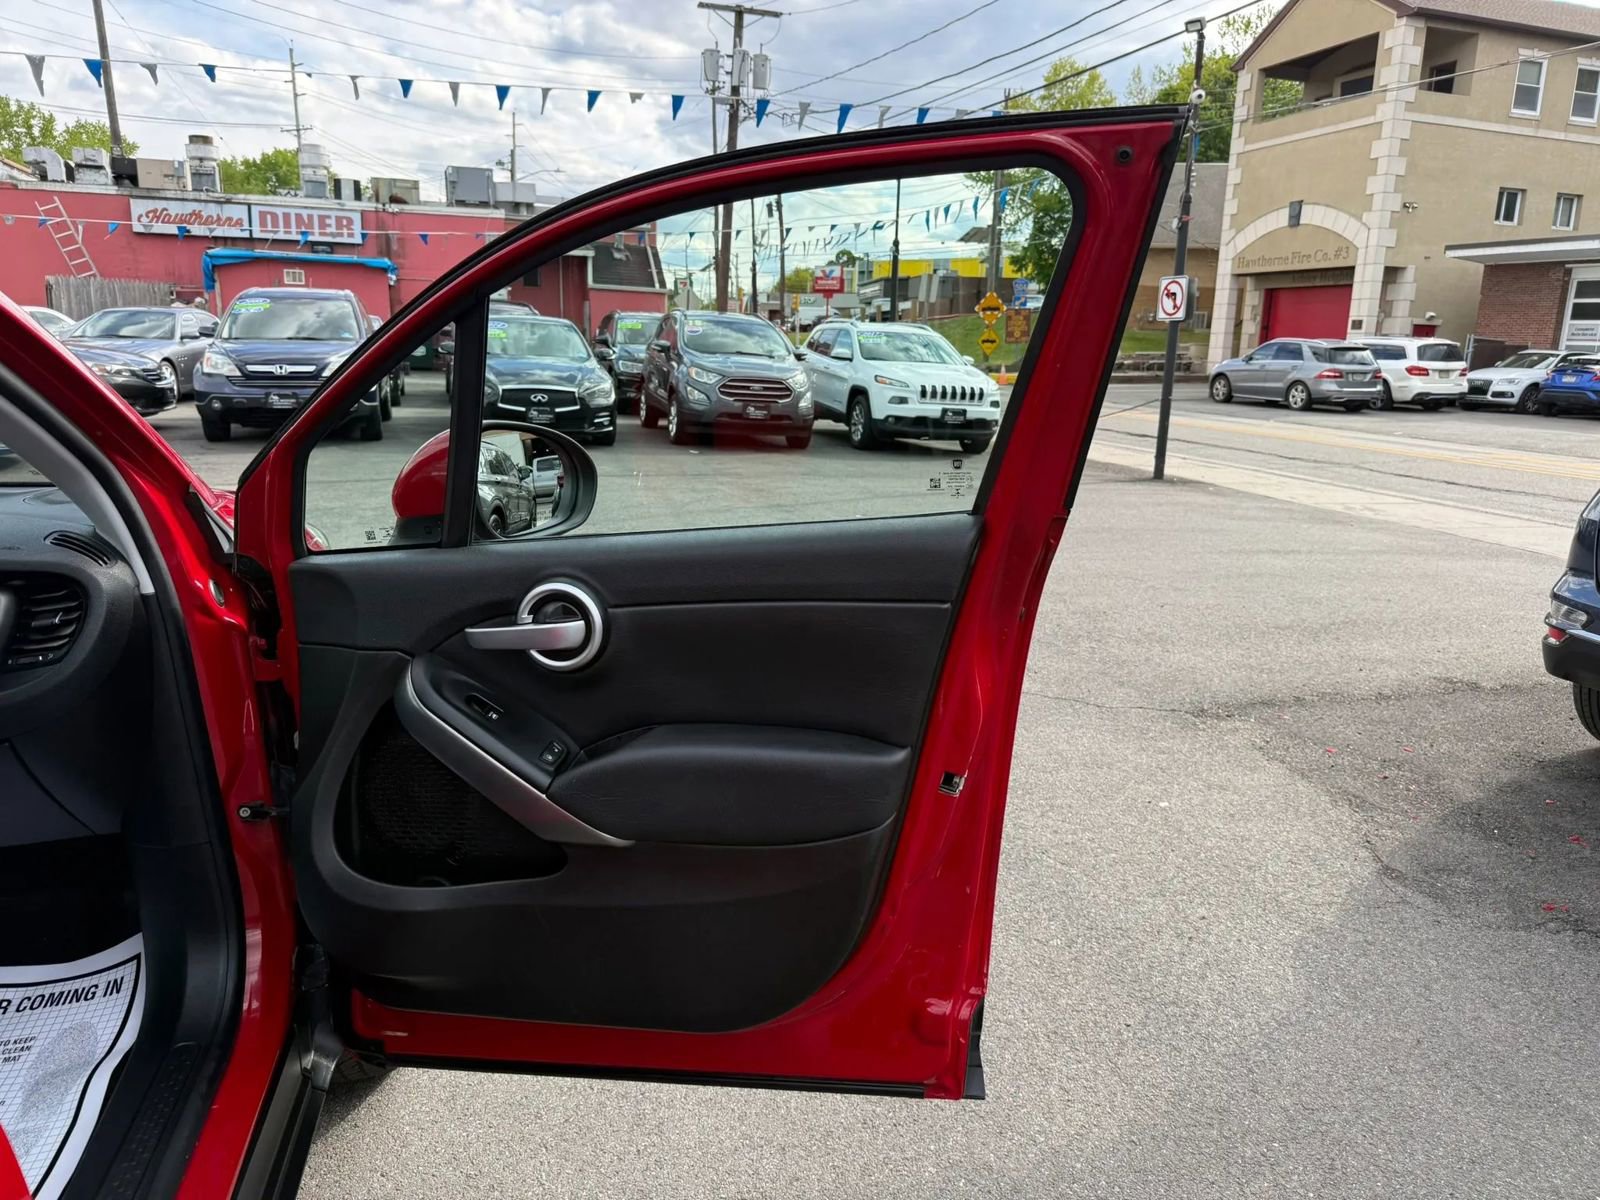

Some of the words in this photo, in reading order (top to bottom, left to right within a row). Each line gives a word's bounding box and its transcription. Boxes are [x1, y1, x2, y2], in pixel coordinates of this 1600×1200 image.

[137, 207, 244, 228] Hawthorne
[258, 210, 355, 238] DINER
[1237, 254, 1289, 269] Hawthorne
[1291, 251, 1312, 265] Fire
[1313, 249, 1331, 263] Co.
[1333, 246, 1350, 261] #3
[15, 984, 99, 1013] COMING
[103, 976, 124, 998] IN
[12, 1036, 36, 1045] KEEP
[2, 1045, 31, 1055] CLEAN
[2, 1055, 21, 1063] MAT
